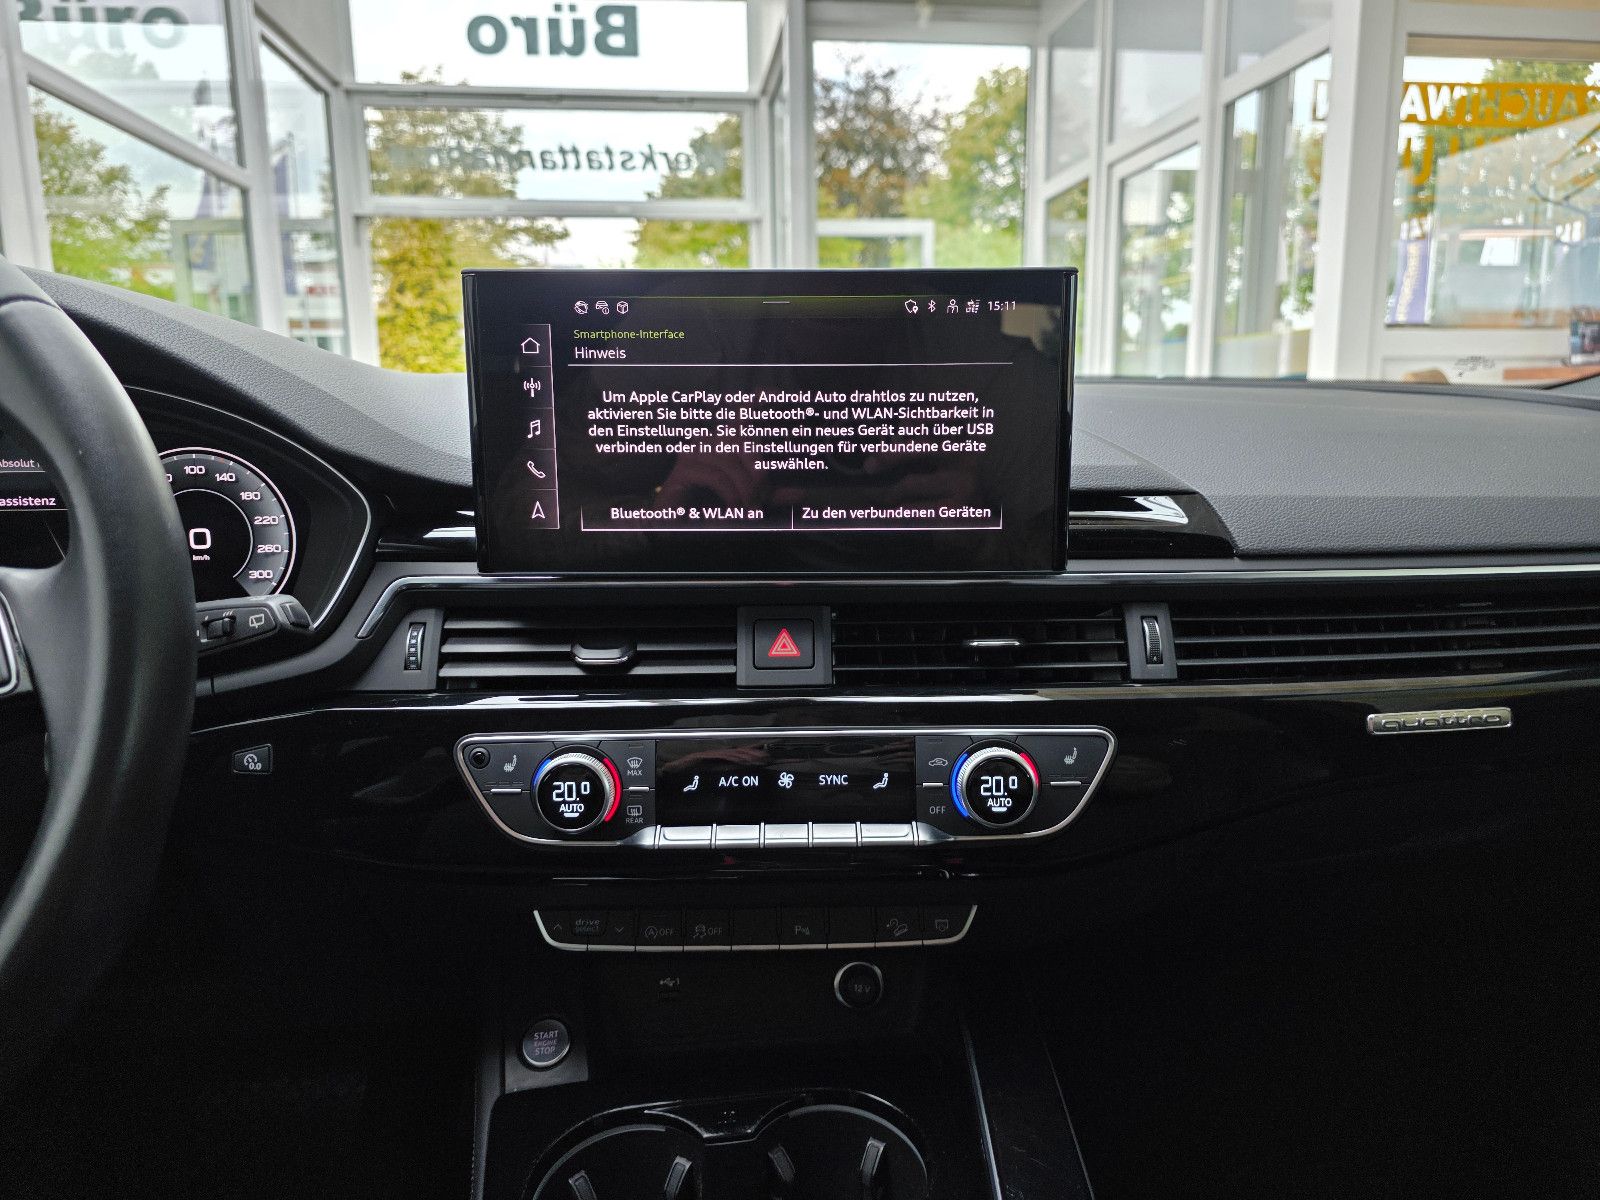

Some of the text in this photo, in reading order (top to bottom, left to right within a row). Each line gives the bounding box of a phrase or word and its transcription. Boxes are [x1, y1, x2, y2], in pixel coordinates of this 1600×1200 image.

[987, 300, 1016, 311] 15:11
[573, 329, 685, 341] Smartphone-Interface
[574, 346, 627, 359] Hinweis
[602, 390, 980, 406] Um Apple CarPlay oder Android Auto drahtlos zu nutzen,
[587, 406, 995, 420] aktivieren Sie bitte die Bluetooth®- und WLAN-Sichtbarkeit in
[588, 423, 994, 440] den Einstellungen. Sie können ein neues Gerät auch über USB
[595, 440, 987, 456] verbinden oder in den Einstellungen für verbundene Geräte
[754, 458, 829, 470] auswählen.
[184, 465, 206, 474] 100
[214, 472, 236, 482] 140
[0, 496, 57, 506] assistenz
[239, 492, 261, 501] 180
[610, 506, 764, 519] Bluetooth® & WLAN an
[801, 505, 992, 519] Zu den verbundenen Geräten
[254, 516, 279, 525] 220
[189, 528, 212, 550] 0
[257, 544, 282, 553] 260
[249, 570, 273, 579] 300
[1381, 713, 1503, 733] quattro
[627, 769, 643, 777] MAX
[718, 776, 760, 787] A/C ON
[818, 774, 849, 786] SYNC
[987, 798, 1012, 807] AUTO
[559, 803, 585, 813] AUTO
[929, 805, 947, 815] OFF
[625, 816, 644, 824] REAR
[533, 1030, 559, 1040] START
[535, 1046, 556, 1056] STOP
